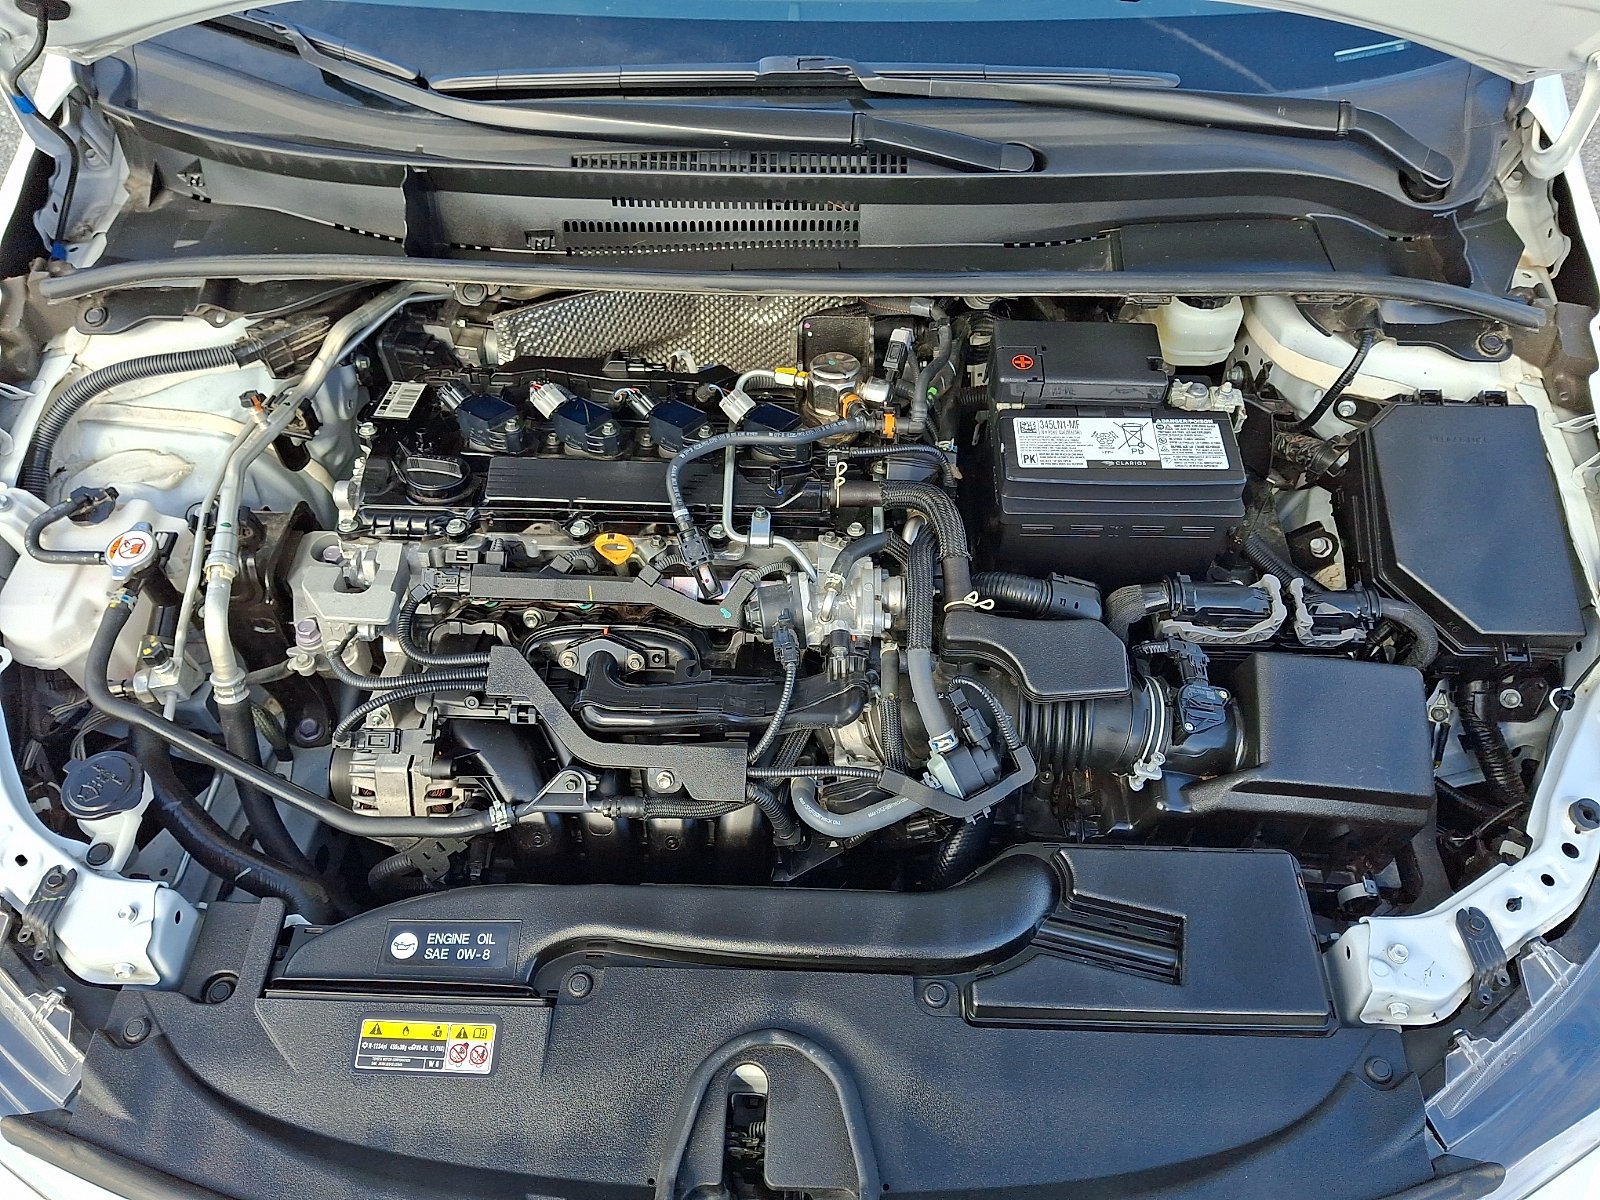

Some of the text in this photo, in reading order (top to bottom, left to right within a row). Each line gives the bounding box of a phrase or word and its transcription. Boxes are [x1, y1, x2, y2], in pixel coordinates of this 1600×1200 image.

[1023, 454, 1036, 463] PK
[427, 933, 496, 944] ENGINE OIL
[424, 948, 491, 960] SAE 0W-8
